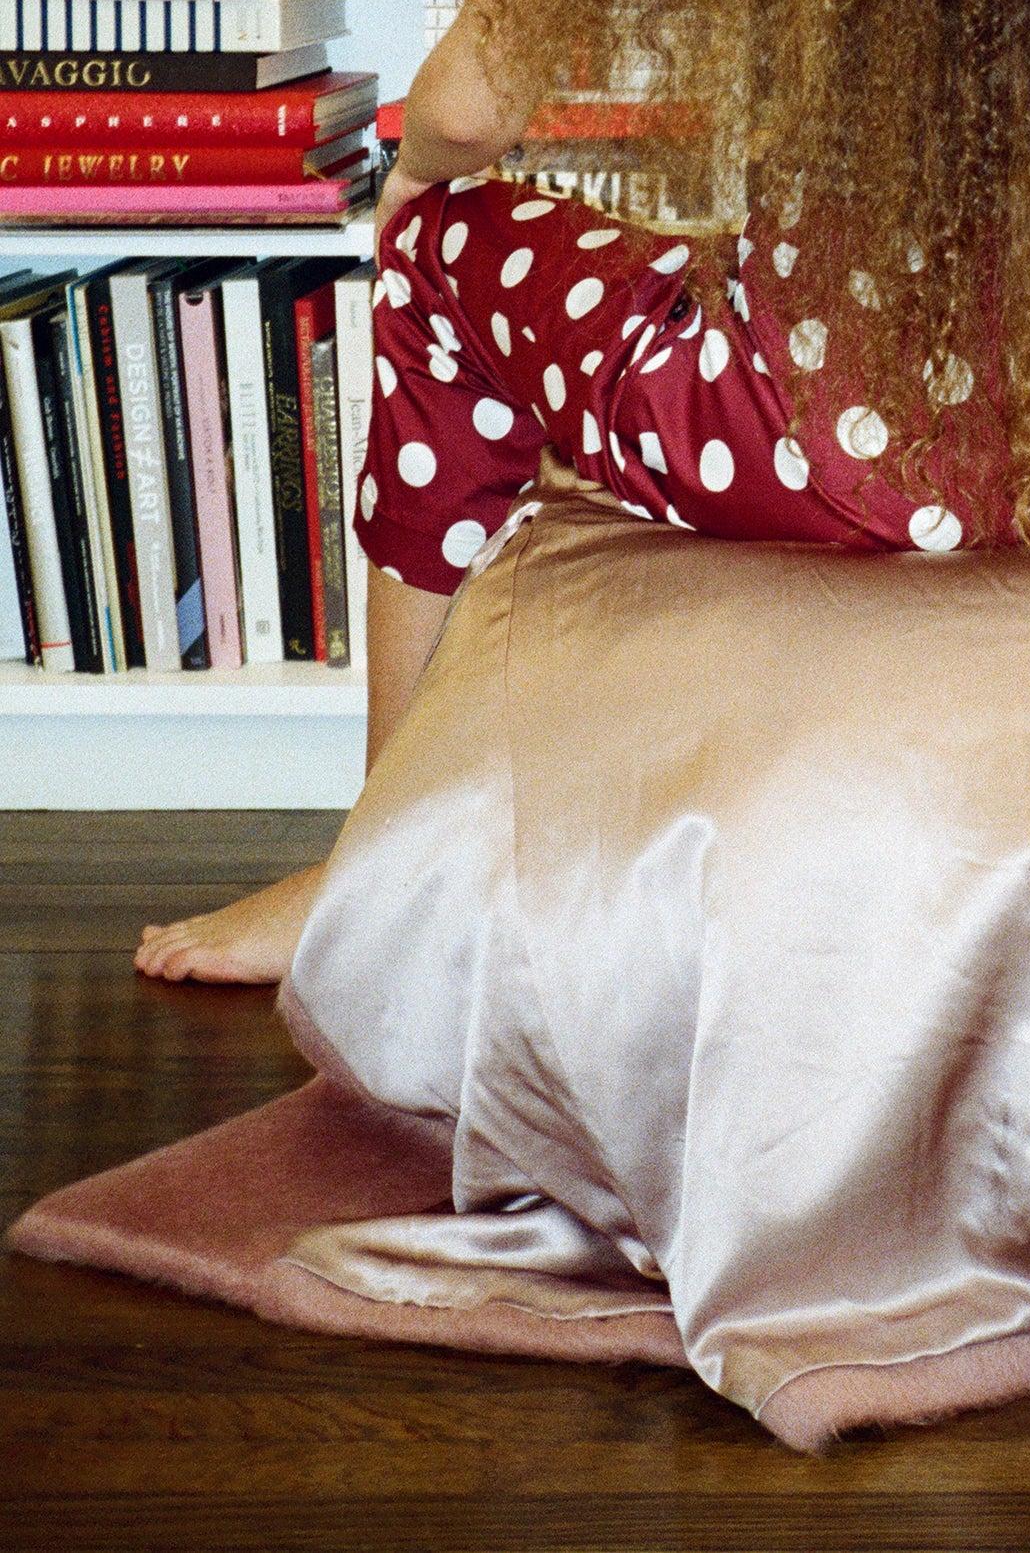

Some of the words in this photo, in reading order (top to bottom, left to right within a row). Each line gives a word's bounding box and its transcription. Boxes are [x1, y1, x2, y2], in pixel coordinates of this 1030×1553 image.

[0, 59, 151, 87] VAGGIO
[43, 154, 190, 181] JEWELRY
[98, 304, 113, 367] Cubism
[107, 375, 119, 404] and
[126, 342, 154, 441] DESIGN
[239, 383, 256, 428] BLITZ
[110, 412, 127, 480] Fashion
[273, 393, 303, 511] EARRINGS
[320, 376, 341, 510] CHARLESTON
[136, 473, 160, 525] ART
